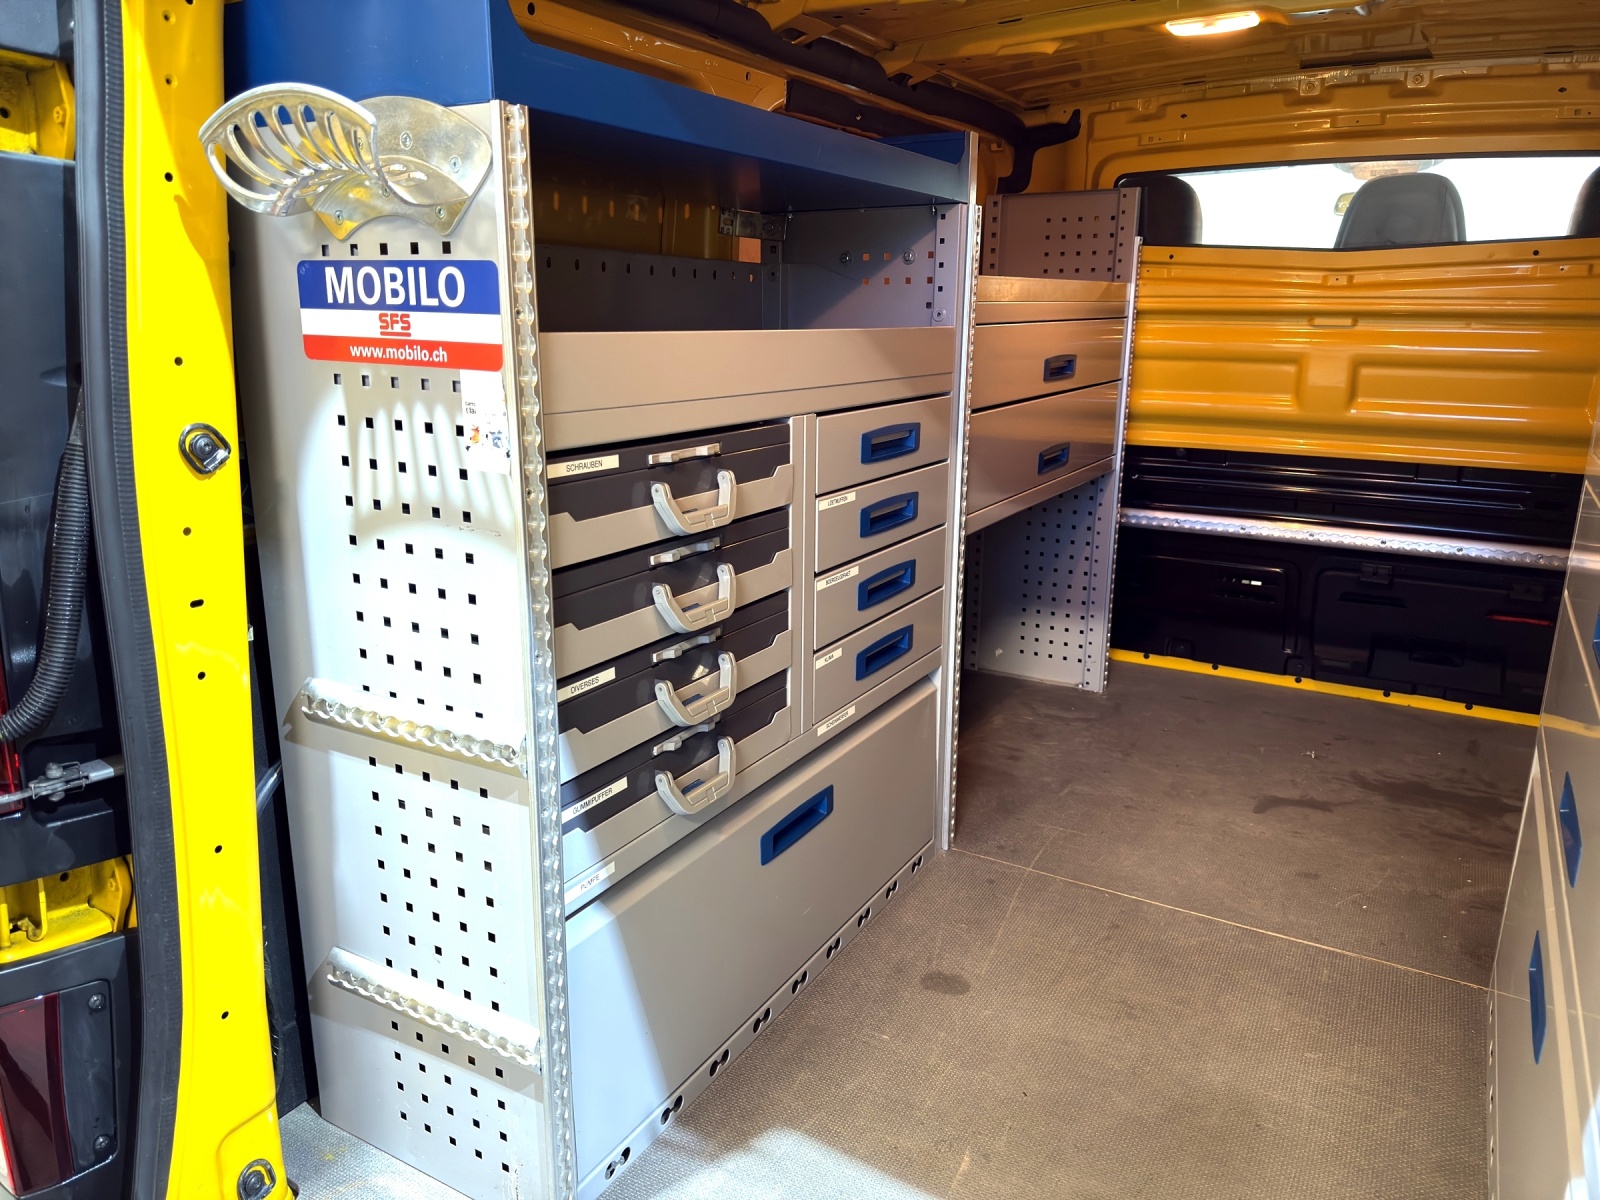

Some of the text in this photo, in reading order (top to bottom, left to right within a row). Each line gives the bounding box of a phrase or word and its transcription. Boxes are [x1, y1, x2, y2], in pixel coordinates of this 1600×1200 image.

[324, 266, 466, 308] MOBILO
[378, 313, 411, 331] SFS
[350, 345, 448, 363] www.mobilo.ch
[566, 459, 603, 473] SCHRAUBEN
[570, 675, 600, 695] DIVERSES
[572, 787, 613, 816] GUMMIPUFFER
